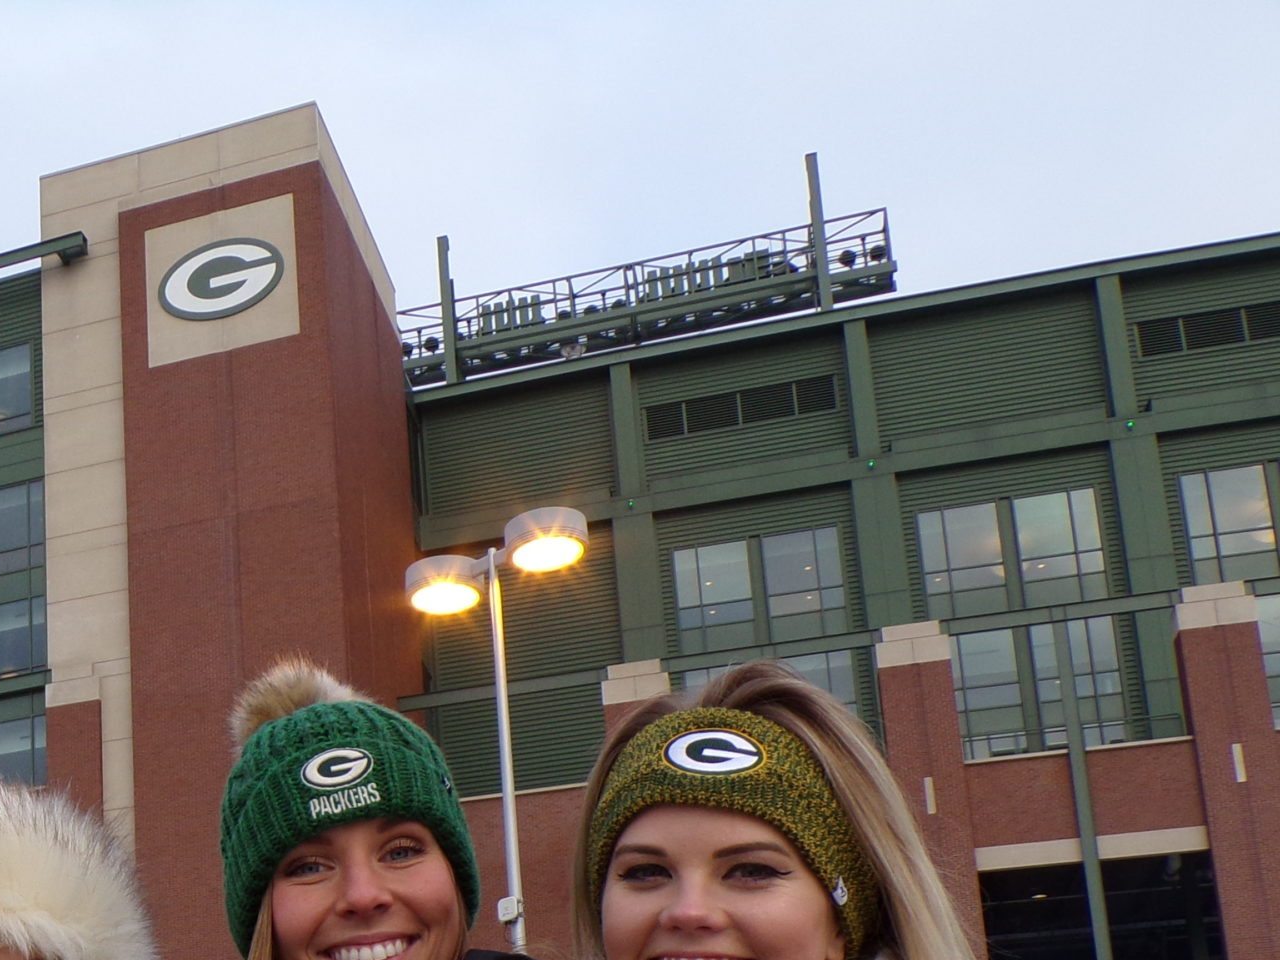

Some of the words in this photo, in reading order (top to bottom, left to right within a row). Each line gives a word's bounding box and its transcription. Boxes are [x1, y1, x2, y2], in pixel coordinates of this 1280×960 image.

[163, 242, 278, 314] G
[304, 748, 370, 787] G
[666, 730, 761, 773] G
[309, 783, 381, 819] PACKERS
